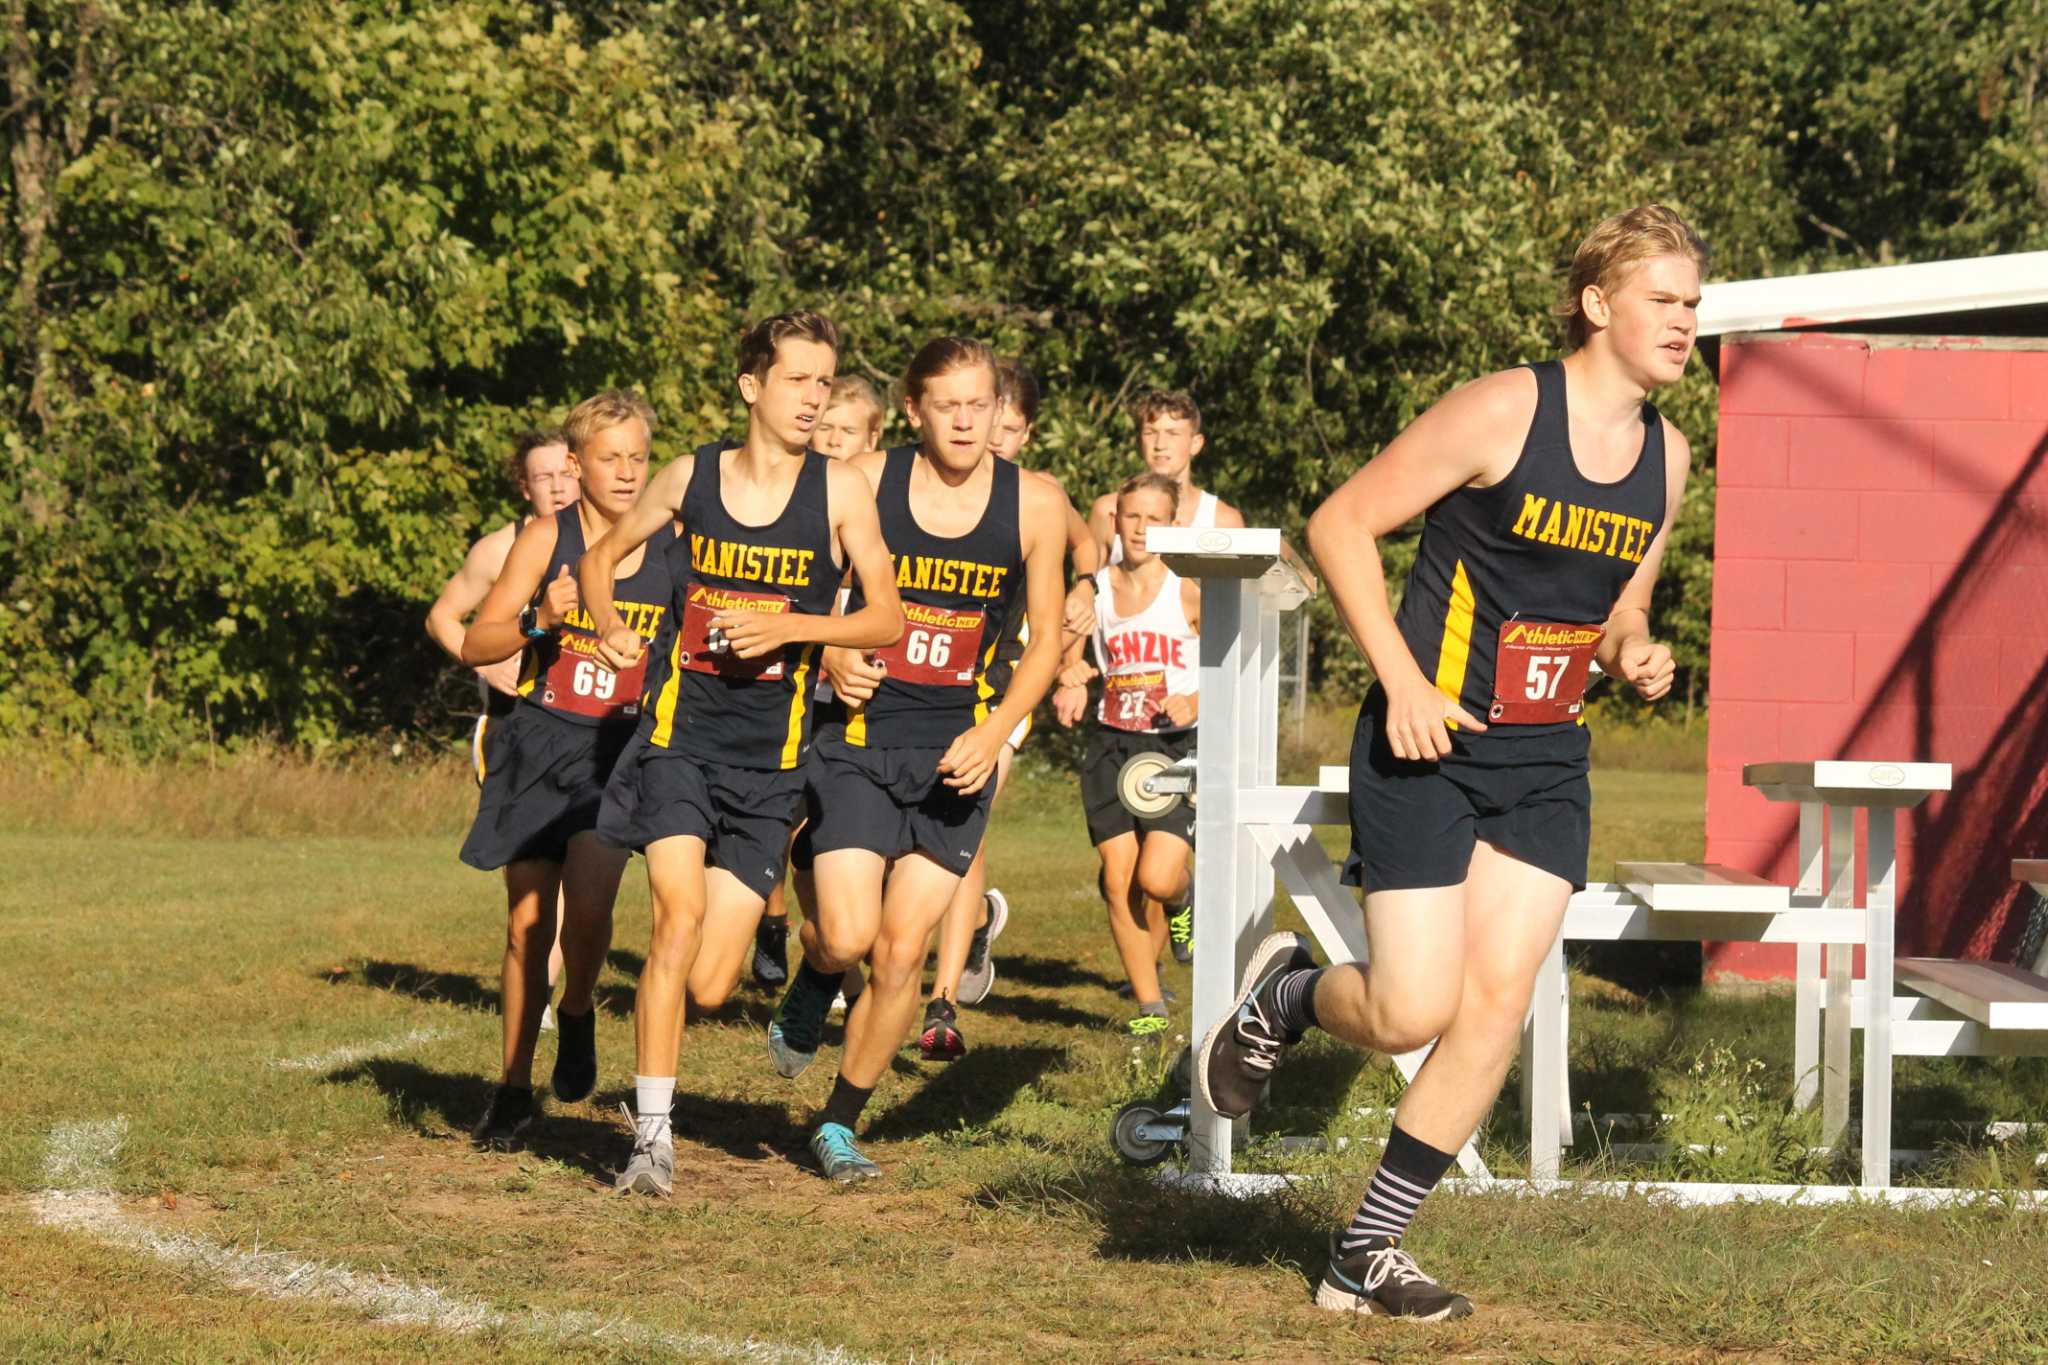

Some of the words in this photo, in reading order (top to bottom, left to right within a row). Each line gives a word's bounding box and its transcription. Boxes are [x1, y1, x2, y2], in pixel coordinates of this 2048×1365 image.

[1511, 492, 1654, 564] MANISTEE
[690, 533, 814, 587] MANISTEE
[889, 554, 1009, 598] ANISTEE
[906, 629, 953, 668] 66
[1106, 630, 1187, 670] ENZIE
[572, 660, 617, 700] 69
[1524, 655, 1571, 701] 57
[1119, 691, 1147, 720] 27
